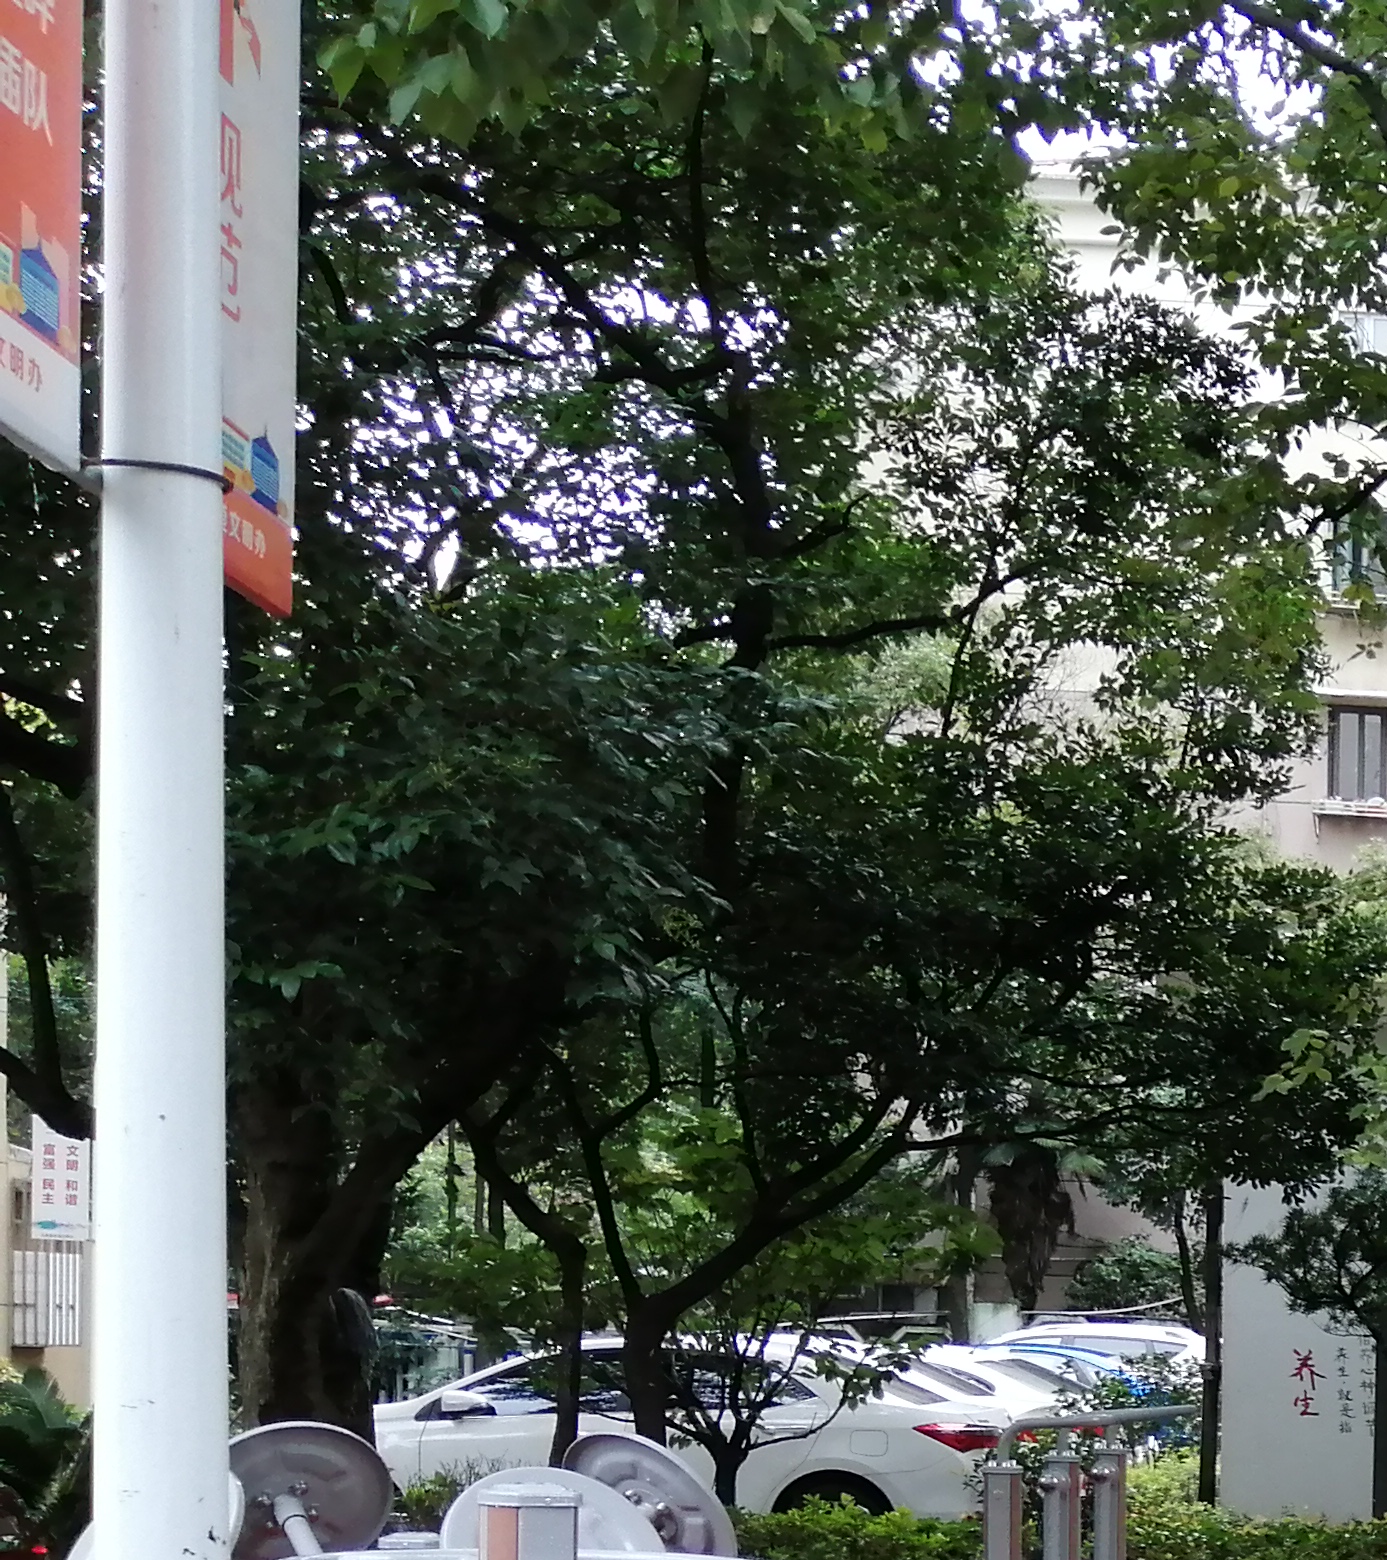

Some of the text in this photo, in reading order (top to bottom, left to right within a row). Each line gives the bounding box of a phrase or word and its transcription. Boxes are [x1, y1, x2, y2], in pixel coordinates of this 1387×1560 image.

[41, 1143, 56, 1205] 富强 民主
[66, 1145, 79, 1172] 文明
[65, 1180, 78, 1206] 和谐
[1289, 1348, 1328, 1416] 养生
